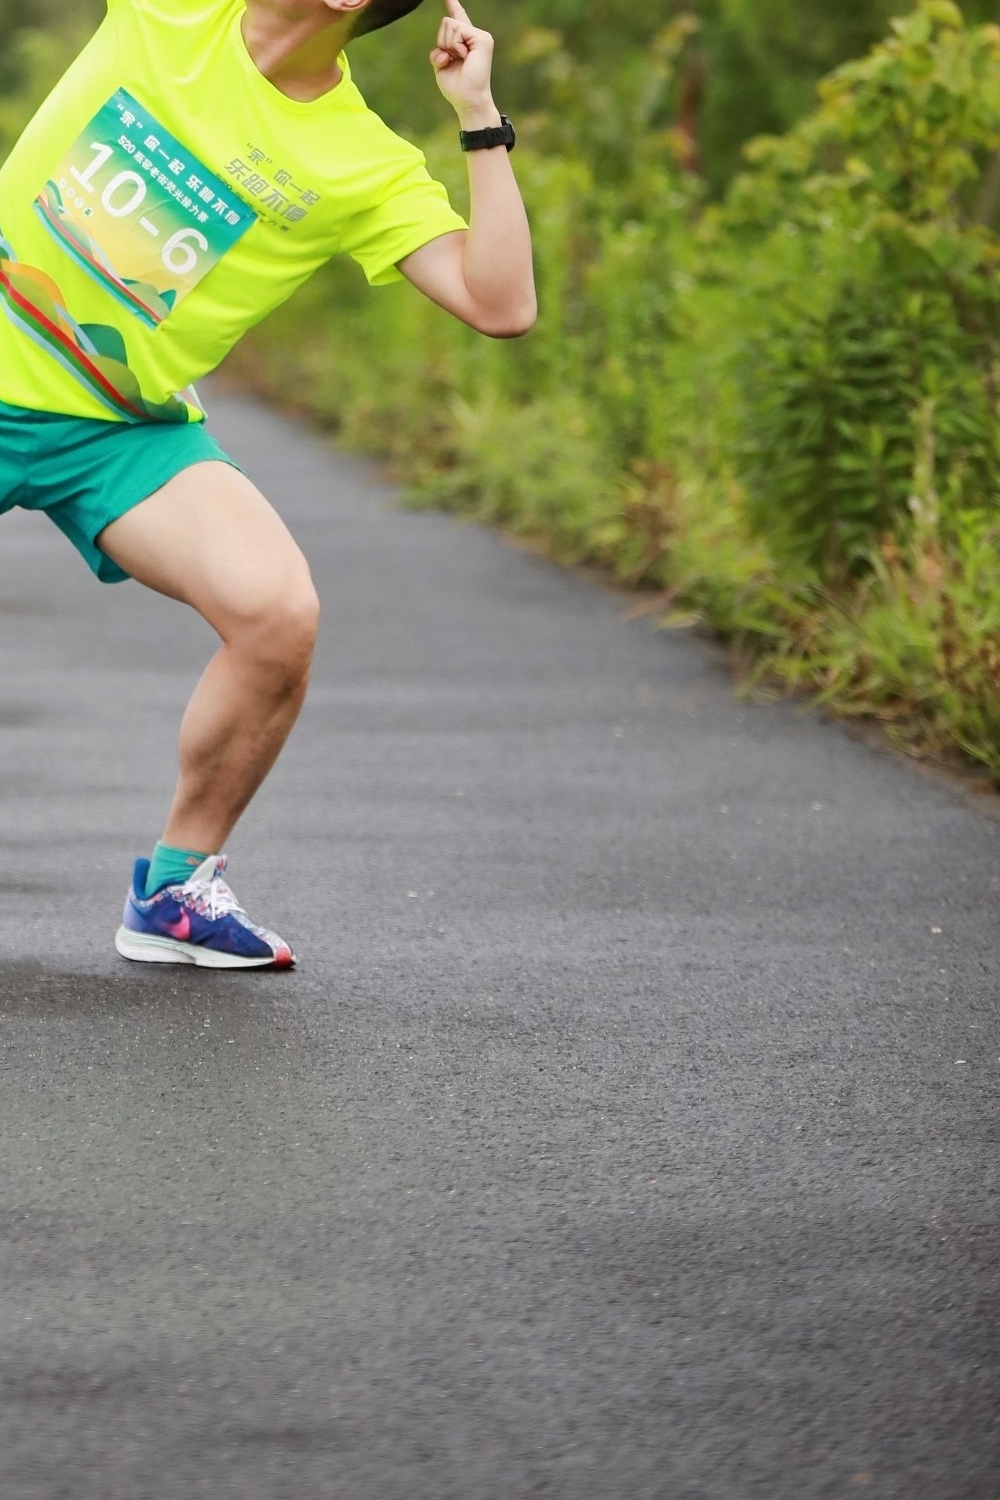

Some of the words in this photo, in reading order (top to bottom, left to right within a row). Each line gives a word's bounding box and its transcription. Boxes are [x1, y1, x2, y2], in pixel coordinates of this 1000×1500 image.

[117, 134, 136, 154] 520
[69, 141, 209, 275] 10-6
[143, 134, 186, 176] 你一起
[185, 174, 241, 225] 乐跑不停
[224, 158, 308, 223] 乐跑不停
[273, 169, 321, 206] 你一起
